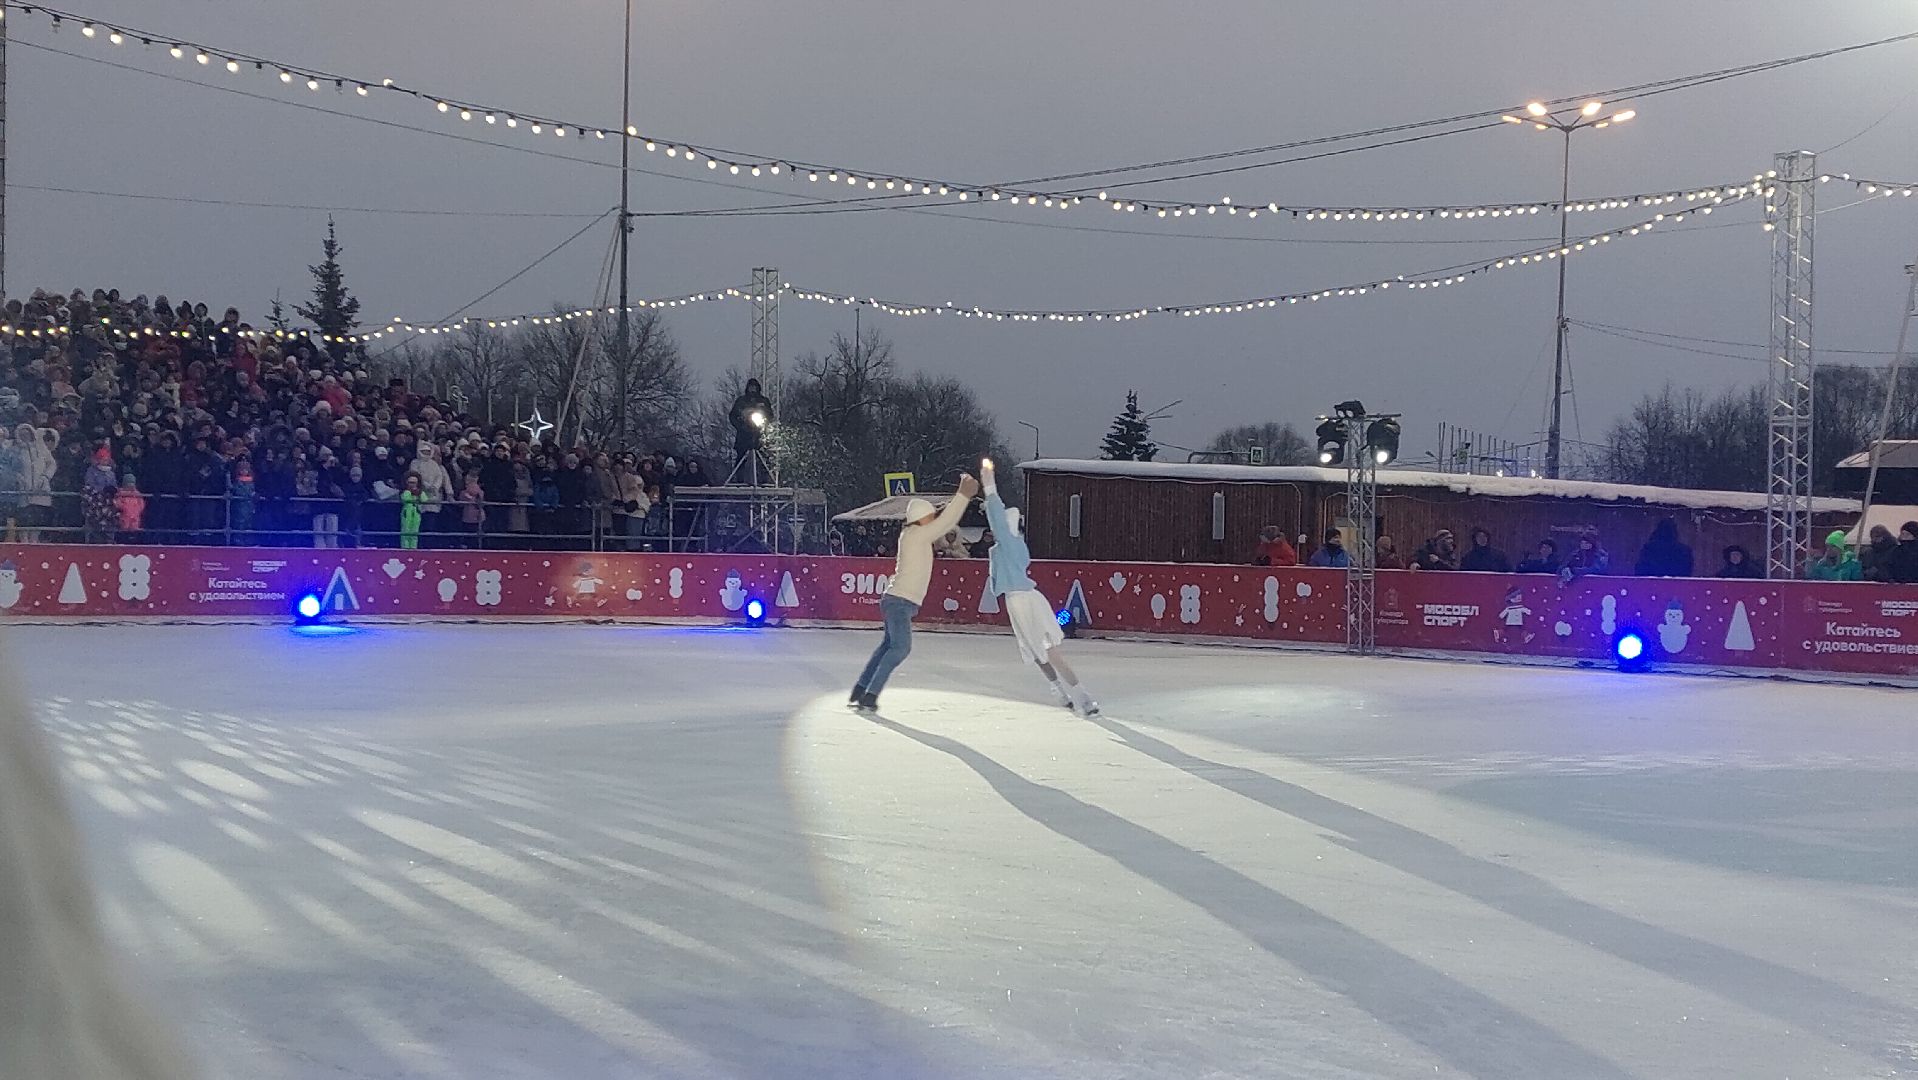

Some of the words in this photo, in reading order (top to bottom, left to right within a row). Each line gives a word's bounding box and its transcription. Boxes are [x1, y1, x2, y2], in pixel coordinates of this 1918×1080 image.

[208, 577, 267, 588] Катайтесь
[198, 592, 285, 603] удовольствием
[1423, 604, 1480, 616] МОСОБЛ
[1881, 600, 1918, 609] МОСОБ
[1881, 608, 1917, 617] СПОРТ
[1423, 615, 1468, 627] СПОРТ
[1826, 621, 1902, 638] Катайтесь
[1802, 640, 1812, 650] с
